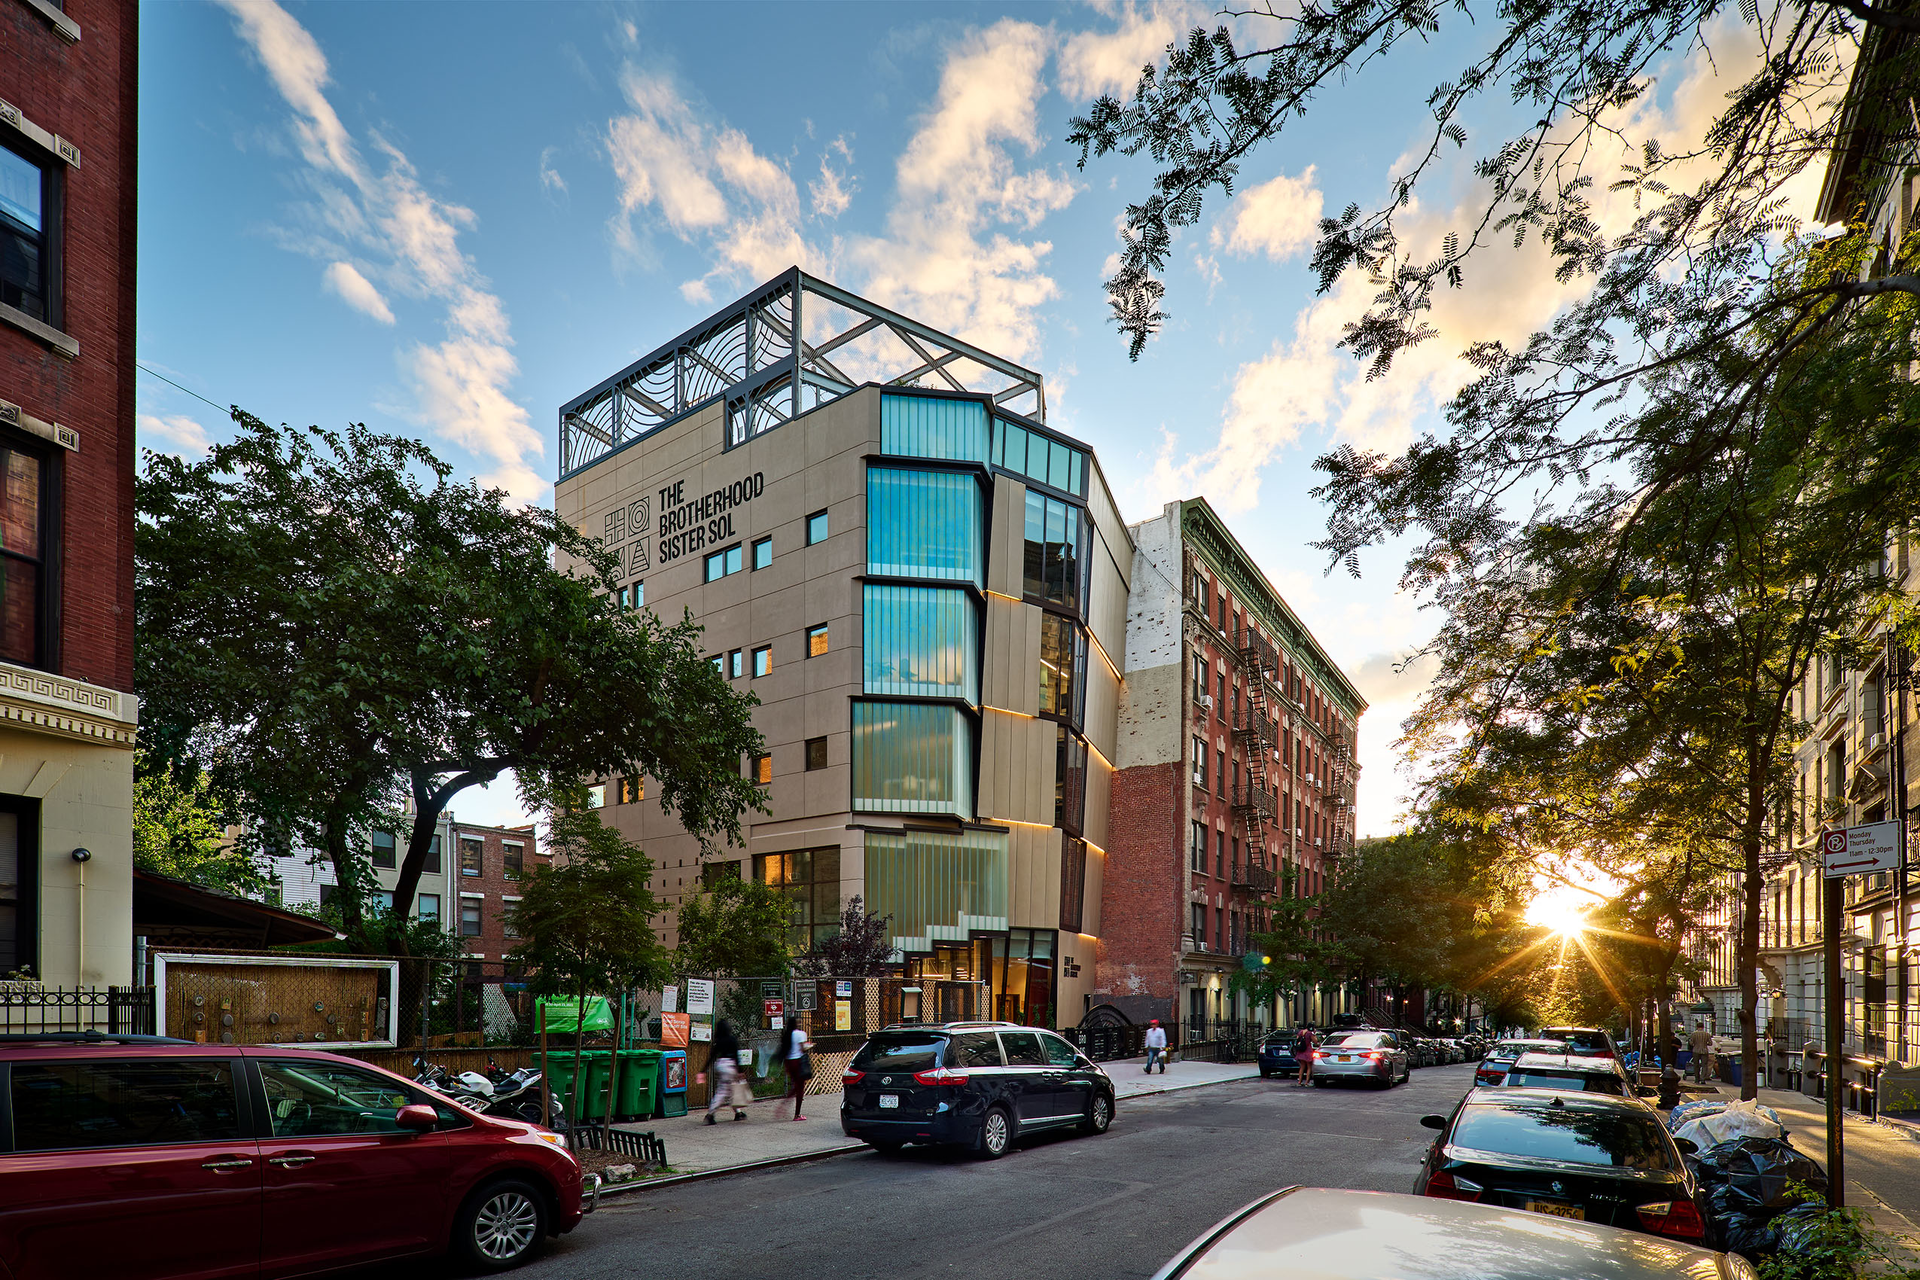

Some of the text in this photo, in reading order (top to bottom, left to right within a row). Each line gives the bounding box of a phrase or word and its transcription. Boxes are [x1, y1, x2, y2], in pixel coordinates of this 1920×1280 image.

[659, 479, 685, 512] THE
[659, 471, 764, 538] BROTHERHOOD
[659, 512, 736, 564] SISTER SOL
[1849, 838, 1875, 846] Thursday
[1868, 847, 1893, 855] 12:30pm
